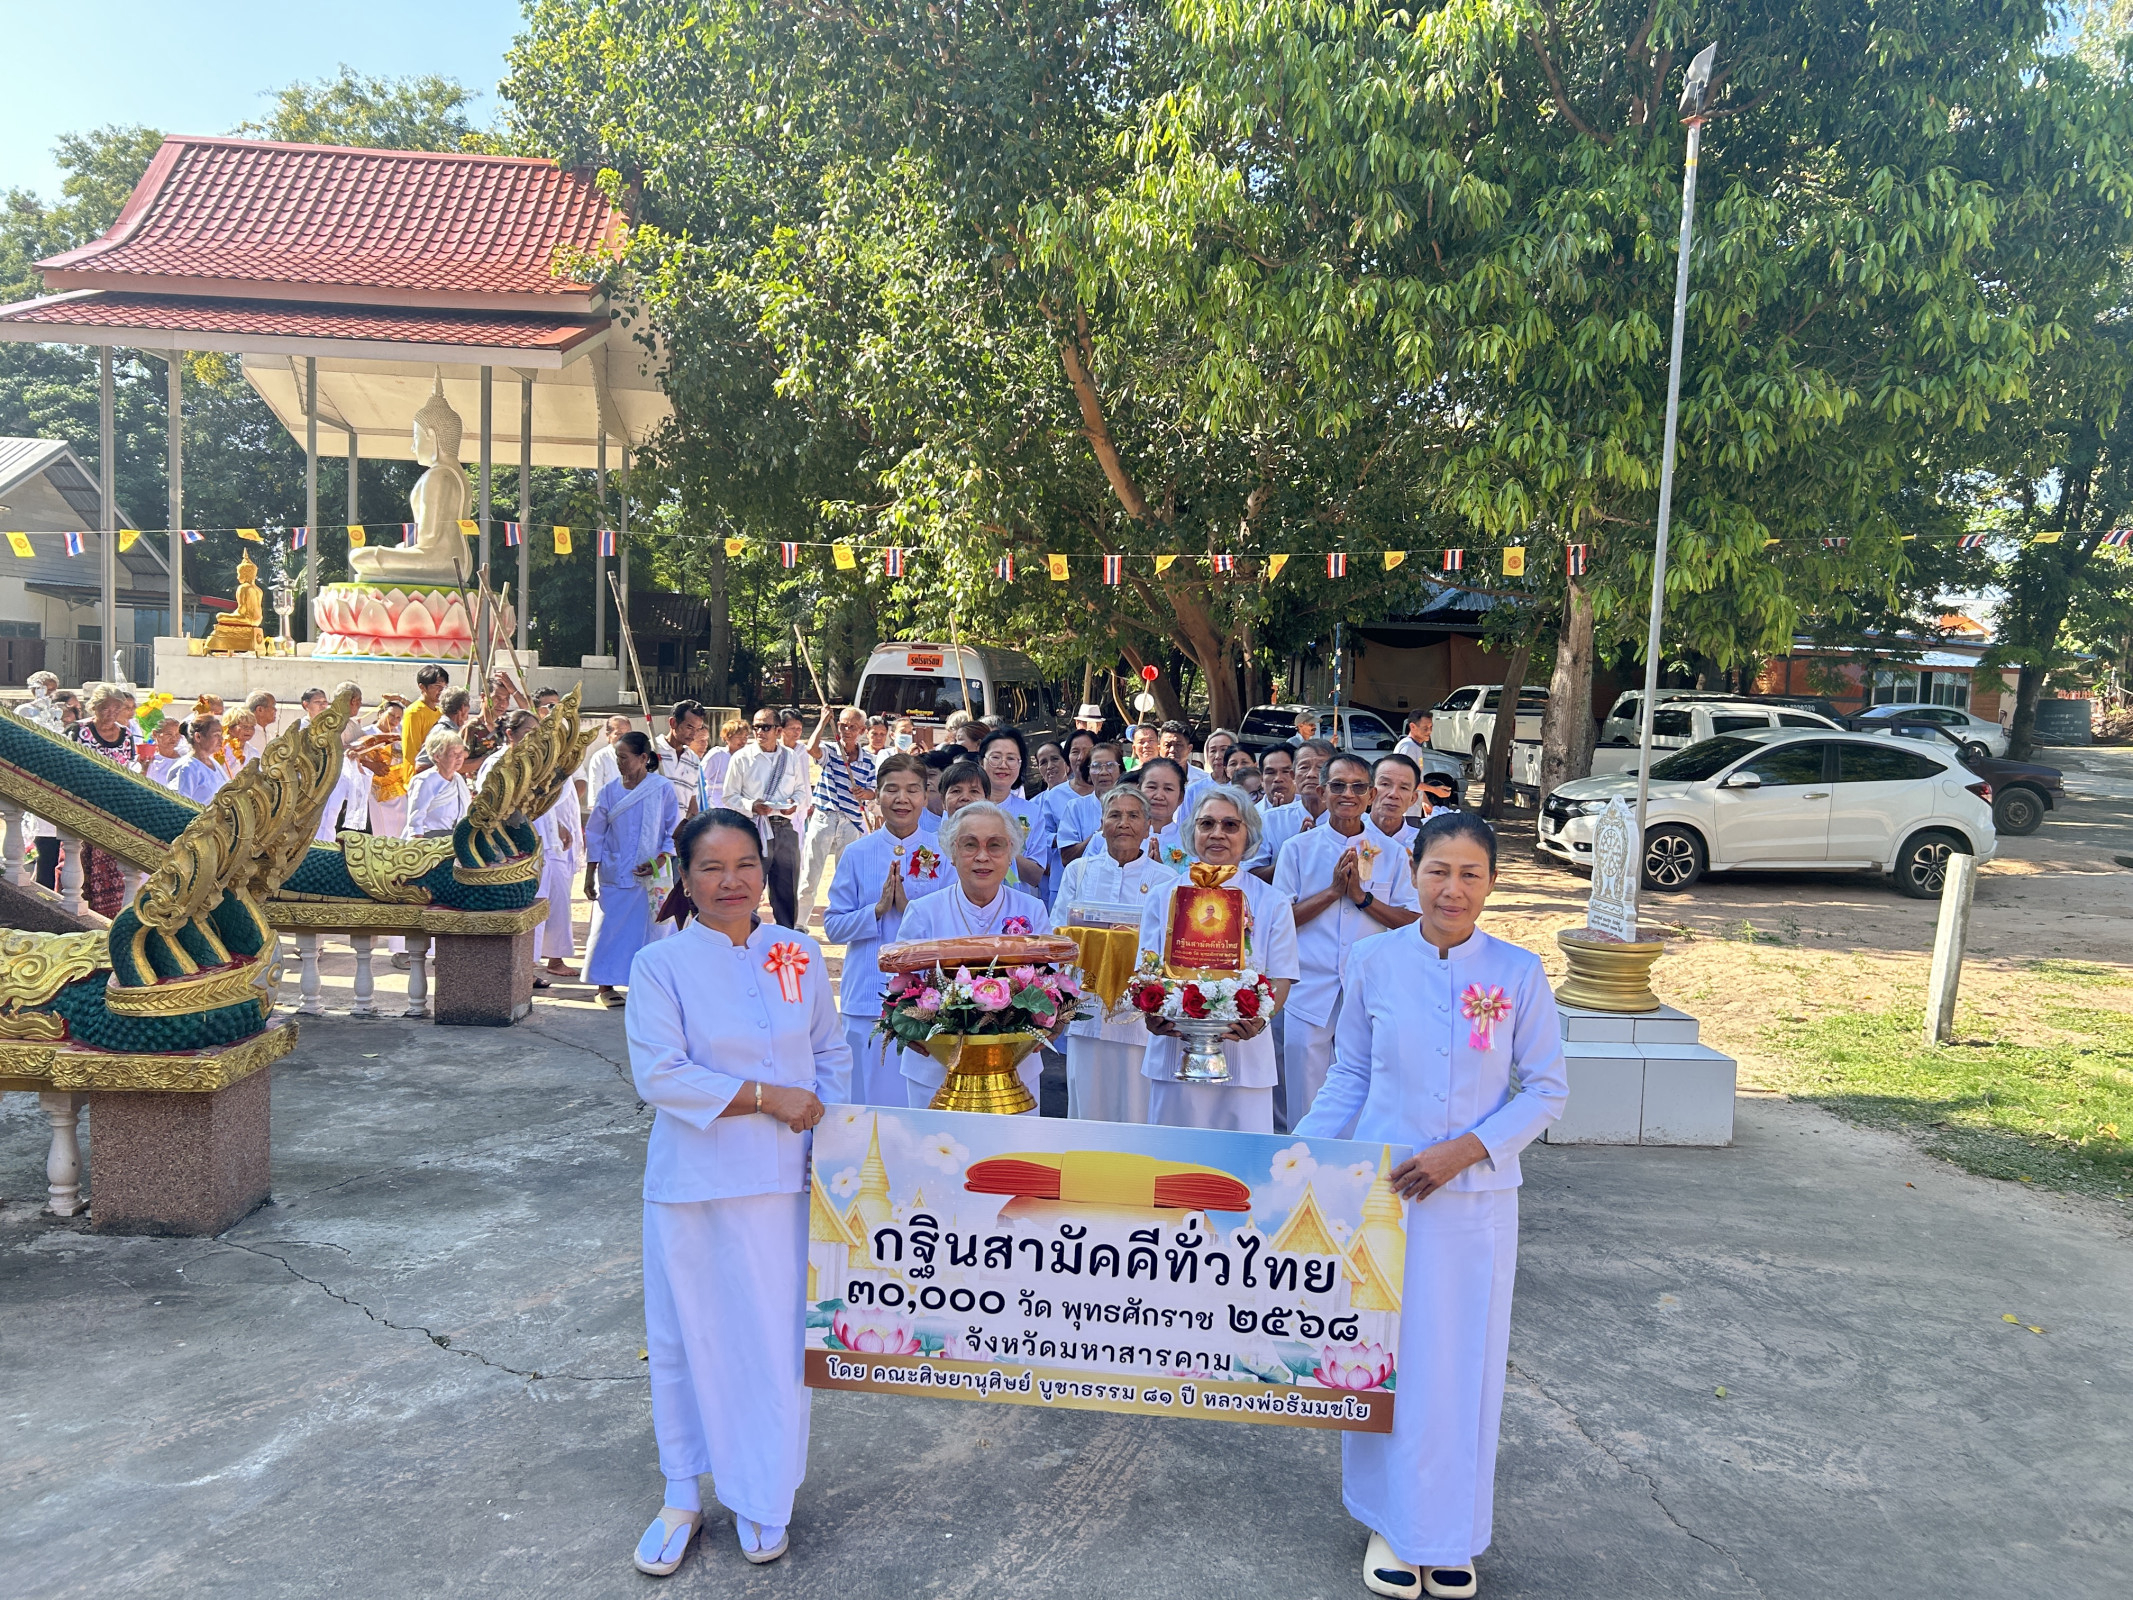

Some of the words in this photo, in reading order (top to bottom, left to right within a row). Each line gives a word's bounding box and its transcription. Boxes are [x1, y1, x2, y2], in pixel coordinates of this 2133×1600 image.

[971, 681, 980, 689] 02
[873, 1213, 1336, 1294] กฐินสามัคคีทั่วไทย
[847, 1279, 1006, 1315] ๓๐,๐๐๐
[1018, 1288, 1053, 1318] วัด
[1061, 1296, 1214, 1331] พุทธศักราช
[1227, 1303, 1360, 1342] ๒๕๖๘
[965, 1325, 1232, 1372] จังหวัดมหาสารคาม
[828, 1356, 866, 1379] โดย
[873, 1365, 1031, 1395] คณะศิษยานุศิษย์
[1039, 1379, 1134, 1401] บูชาธรรม
[1143, 1388, 1173, 1404] ๘๑
[1181, 1386, 1195, 1405] ปี
[1203, 1391, 1369, 1419] หลวงพ่อธัมมชโย
